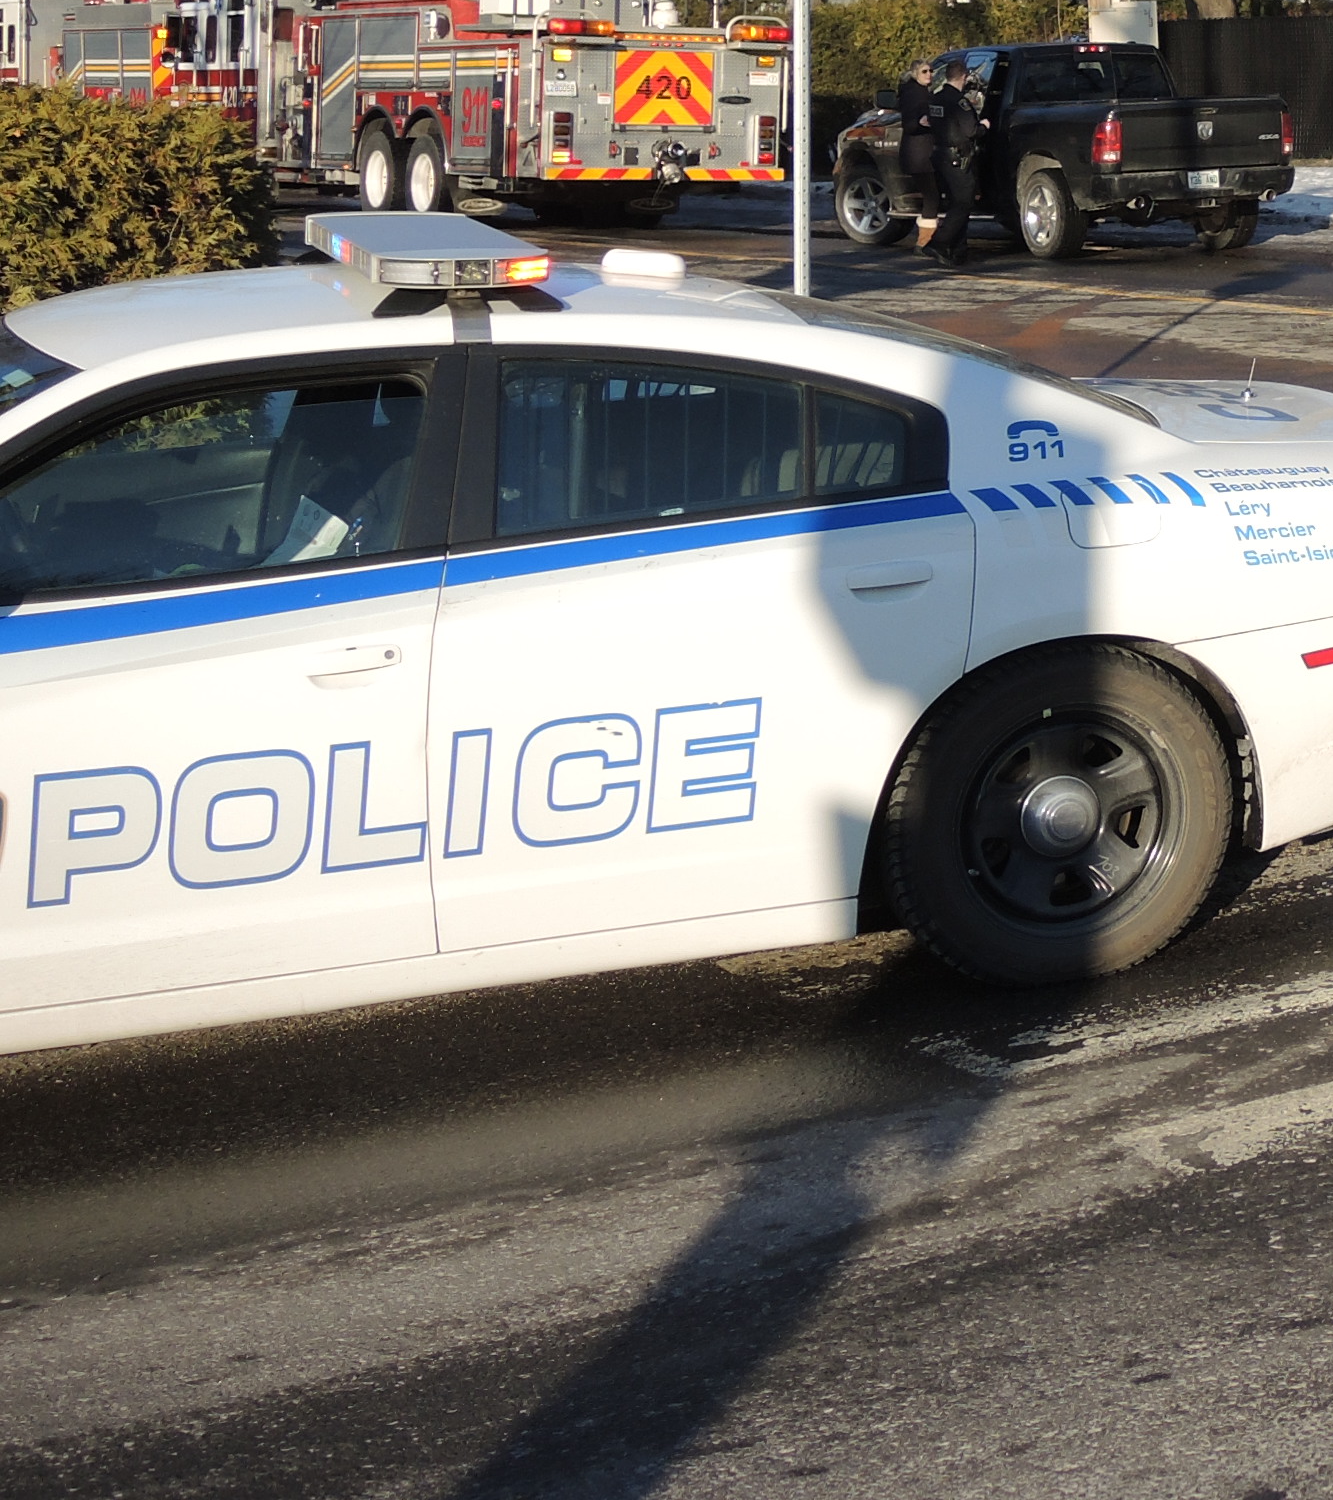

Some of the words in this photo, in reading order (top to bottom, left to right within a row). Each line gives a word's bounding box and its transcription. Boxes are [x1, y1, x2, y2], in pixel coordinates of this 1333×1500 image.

[222, 86, 239, 108] 420
[635, 75, 692, 100] 420
[461, 86, 489, 133] 911
[1008, 439, 1065, 463] 911
[1193, 465, 1330, 479] Châteauguay
[1224, 500, 1272, 517] Léry
[1234, 522, 1317, 542] Mercier
[26, 696, 763, 909] POLICE
